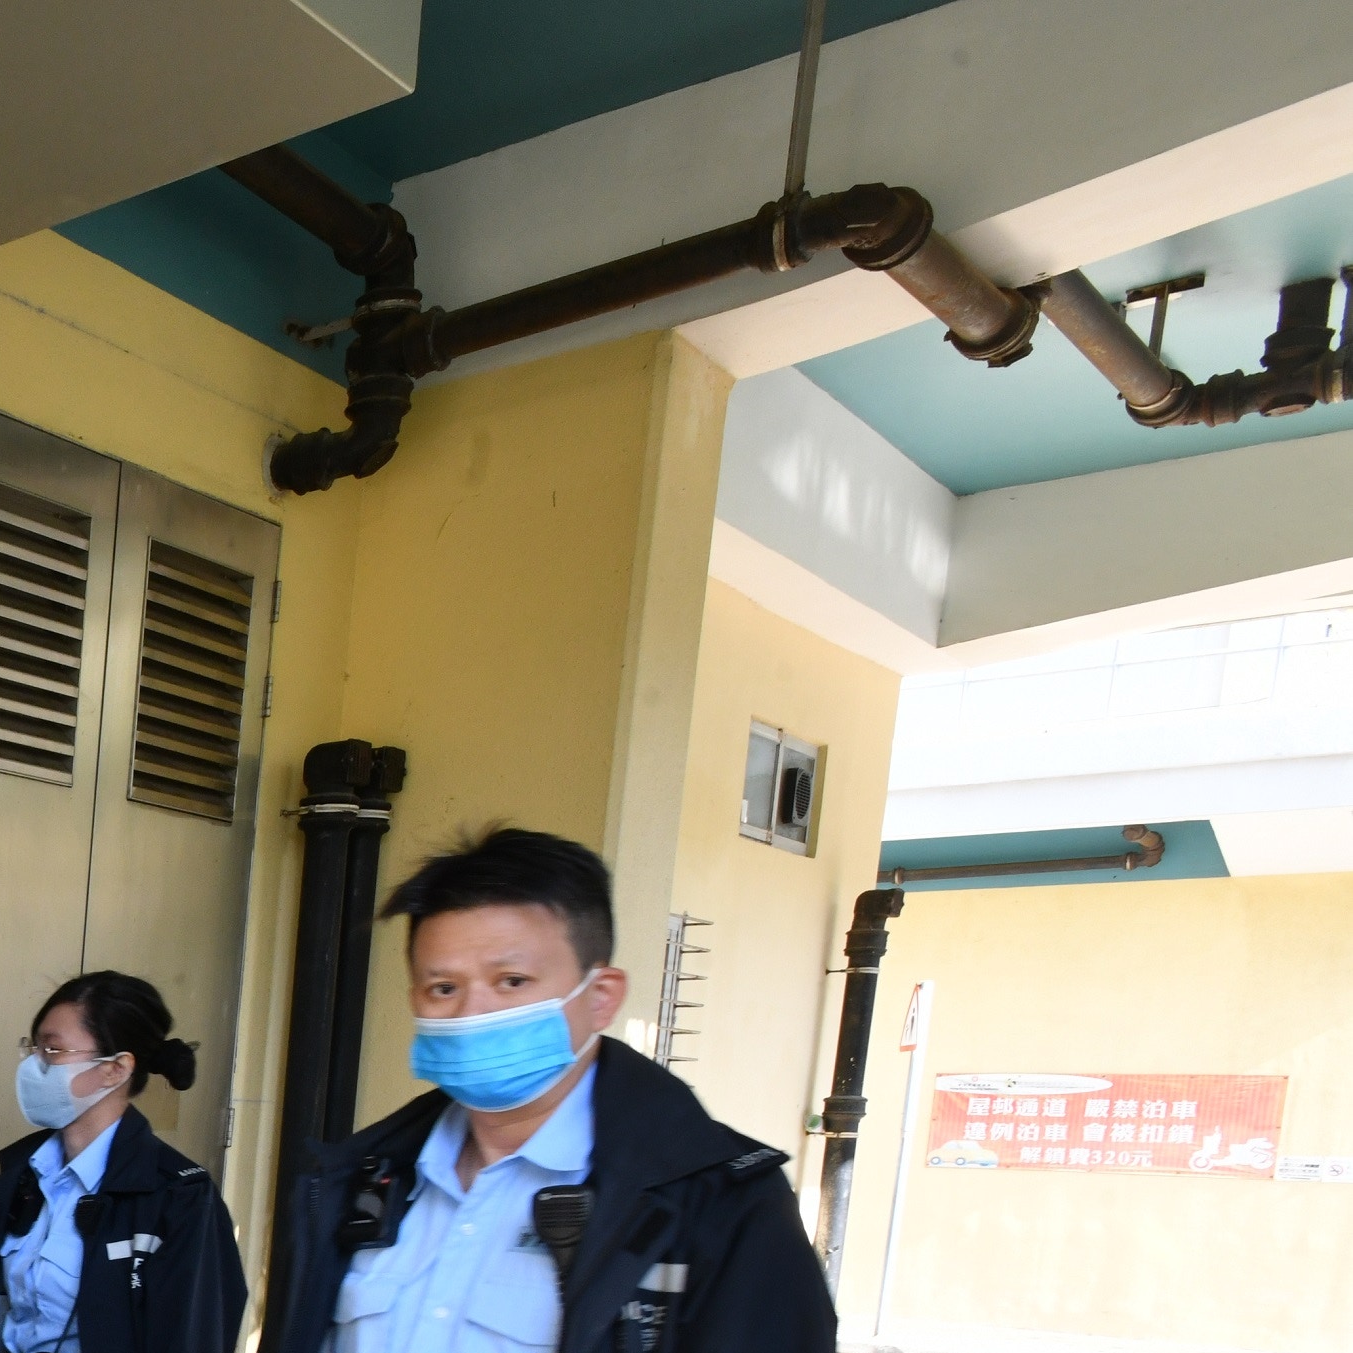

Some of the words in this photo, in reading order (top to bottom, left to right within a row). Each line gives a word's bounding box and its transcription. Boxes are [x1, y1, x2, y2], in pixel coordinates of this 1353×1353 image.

[967, 1097, 1067, 1117] 屋邨通道
[1083, 1098, 1197, 1120] 嚴禁泊車
[962, 1122, 1068, 1142] 違例泊車
[1082, 1122, 1195, 1144] 會被扣鎖
[1019, 1146, 1152, 1167] 解鎖費320元
